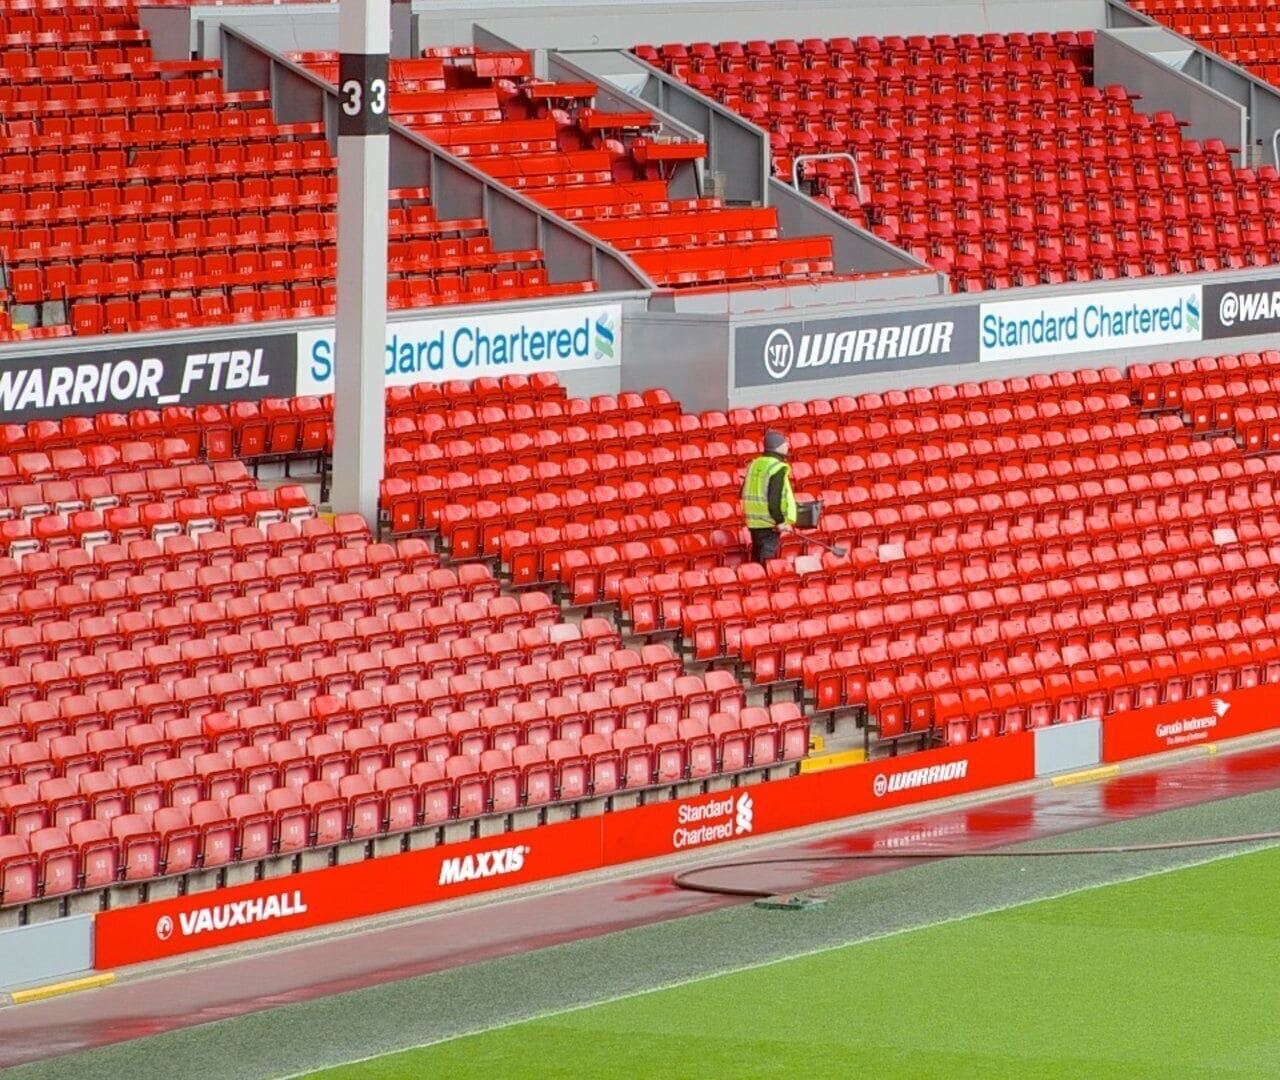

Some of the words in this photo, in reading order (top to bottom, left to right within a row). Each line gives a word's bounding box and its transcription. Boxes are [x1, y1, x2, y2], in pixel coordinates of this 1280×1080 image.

[982, 305, 1078, 348] Standard
[1083, 298, 1182, 339] Chartered
[311, 330, 444, 382] Sdard
[452, 318, 589, 369] Chartered
[797, 322, 954, 369] WARRIOR
[1156, 721, 1182, 737] Garuda
[888, 760, 968, 792] WARRIOR
[678, 794, 733, 822] Standard
[673, 820, 733, 848] Chartered
[439, 845, 525, 884] MAXXIS
[179, 891, 307, 935] VAUXHALL
